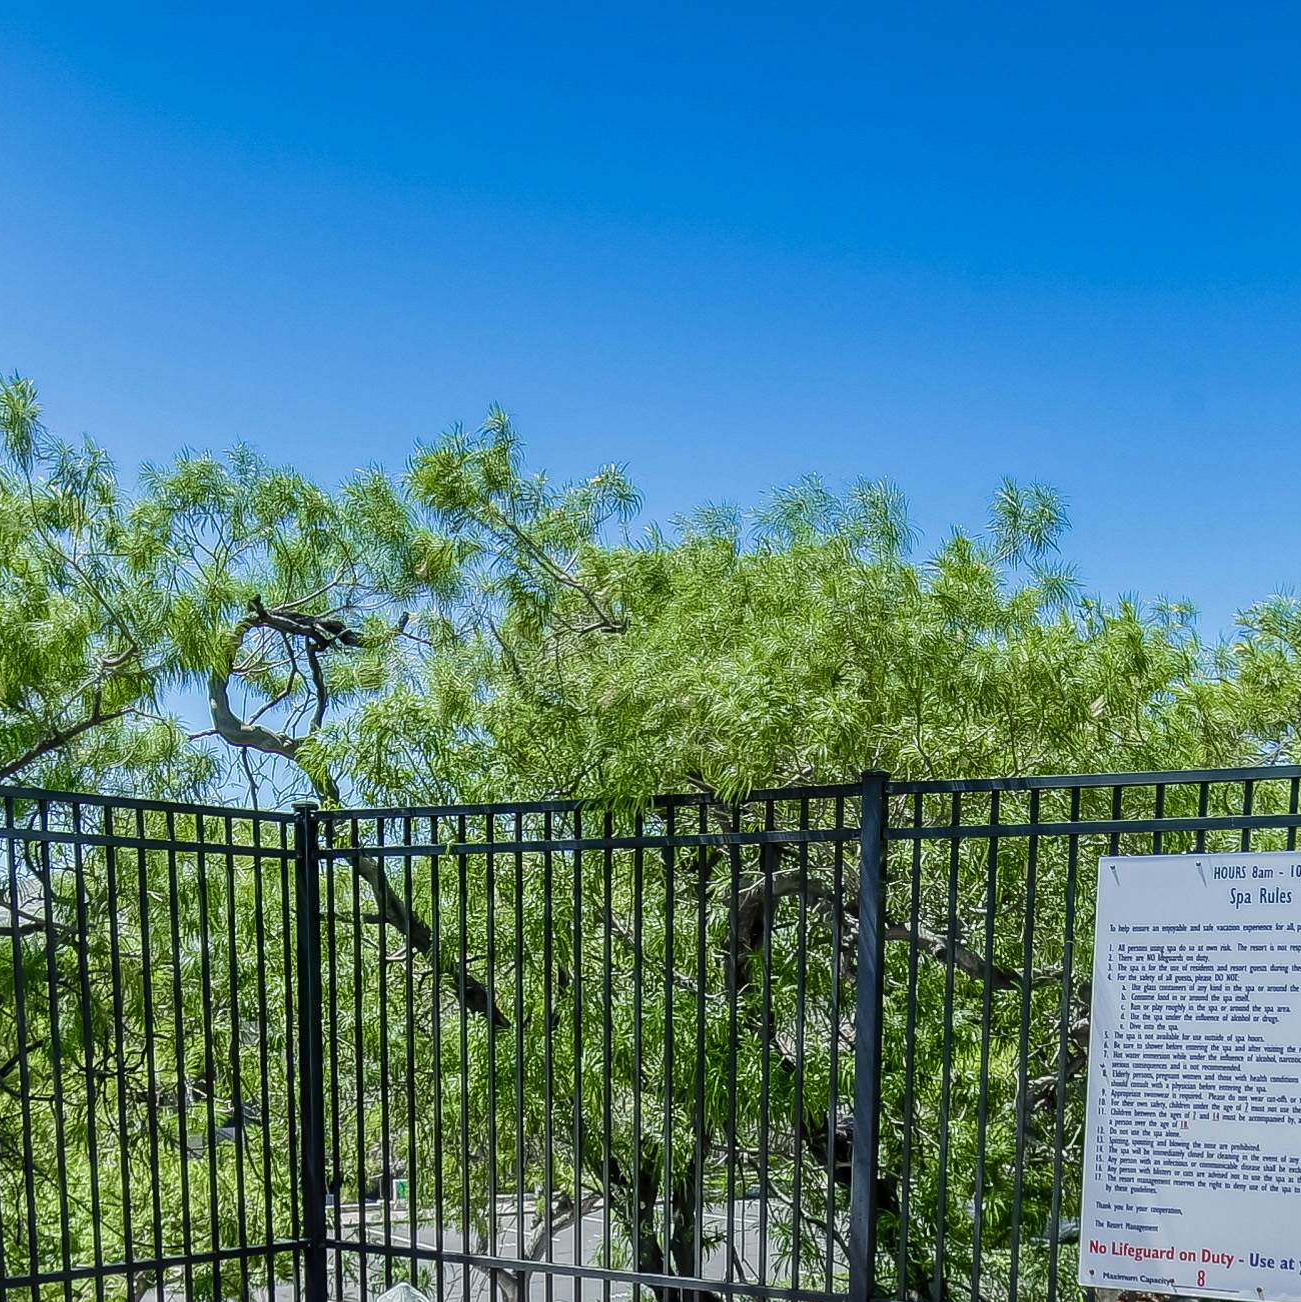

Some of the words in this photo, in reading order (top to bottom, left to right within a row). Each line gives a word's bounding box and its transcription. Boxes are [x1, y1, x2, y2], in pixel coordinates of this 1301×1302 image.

[1214, 866, 1246, 879] HOURS
[1252, 866, 1273, 878] 8am
[1230, 888, 1252, 909] Spa
[1259, 887, 1292, 904] Rules
[1117, 924, 1130, 934] help
[1095, 1219, 1104, 1227] The
[1106, 1220, 1123, 1229] Resort
[1125, 1222, 1158, 1232] Management
[1089, 1239, 1107, 1255] No
[1111, 1242, 1175, 1262] Lifeguard
[1179, 1251, 1196, 1262] on
[1201, 1248, 1235, 1269] Duty
[1249, 1252, 1275, 1269] Use
[1279, 1257, 1295, 1271] at
[1103, 1271, 1138, 1283] Maximum
[1197, 1269, 1206, 1288] 8
